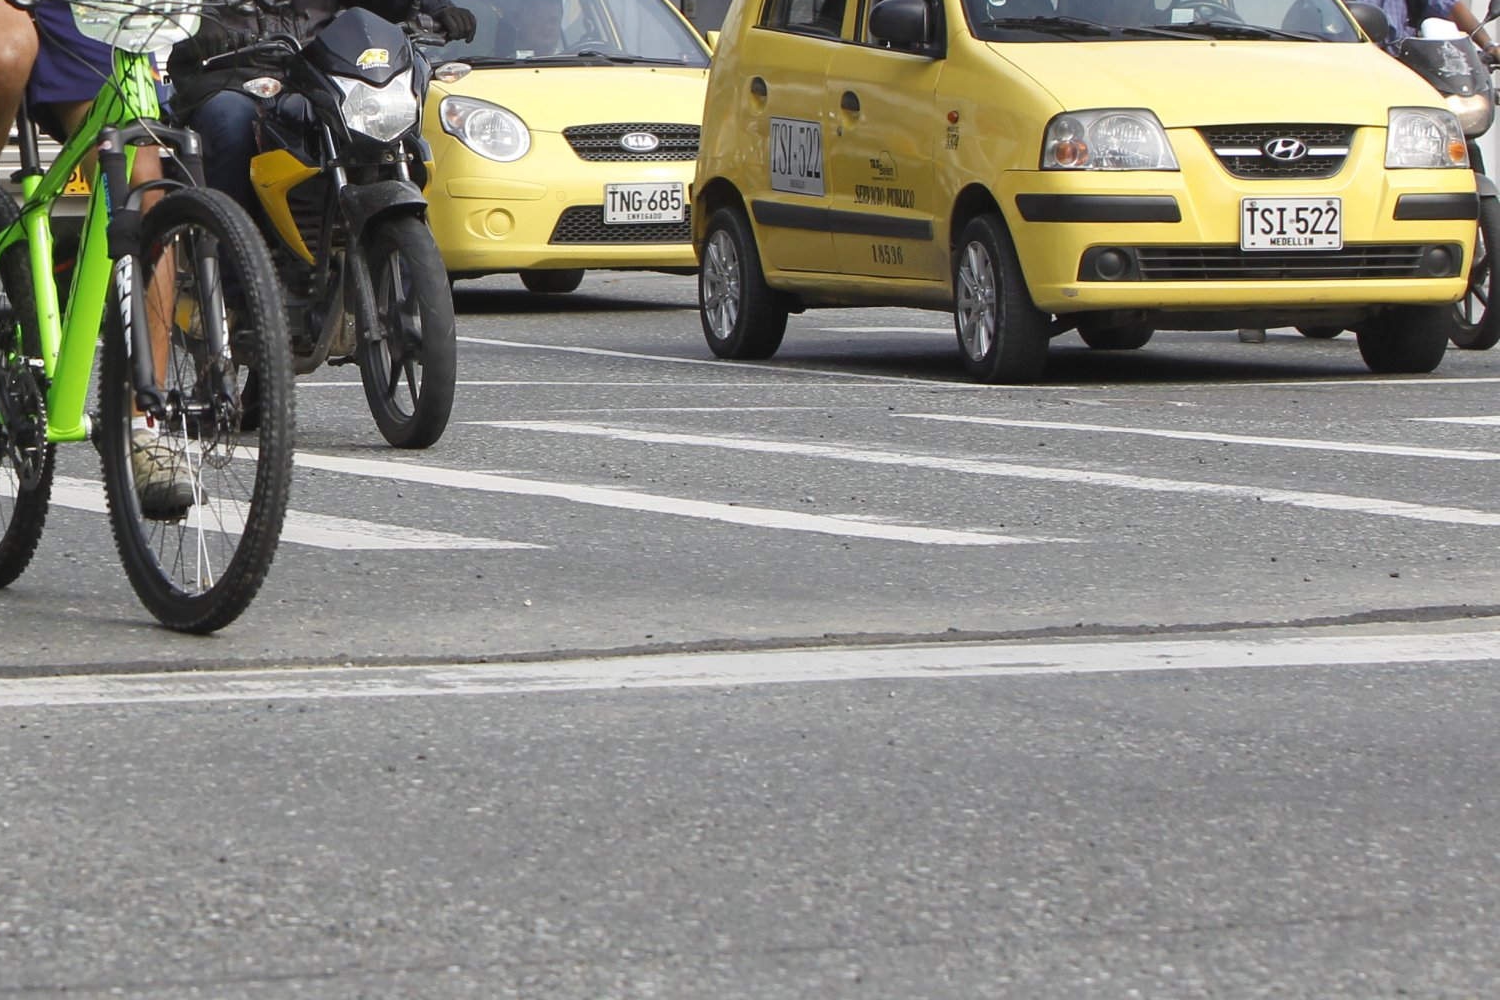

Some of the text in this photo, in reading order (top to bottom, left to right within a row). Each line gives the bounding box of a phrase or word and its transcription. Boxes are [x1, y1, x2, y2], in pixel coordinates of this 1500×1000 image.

[627, 136, 654, 147] KIA
[627, 213, 662, 221] ENVIGADO
[1269, 237, 1314, 246] MEDELLIN
